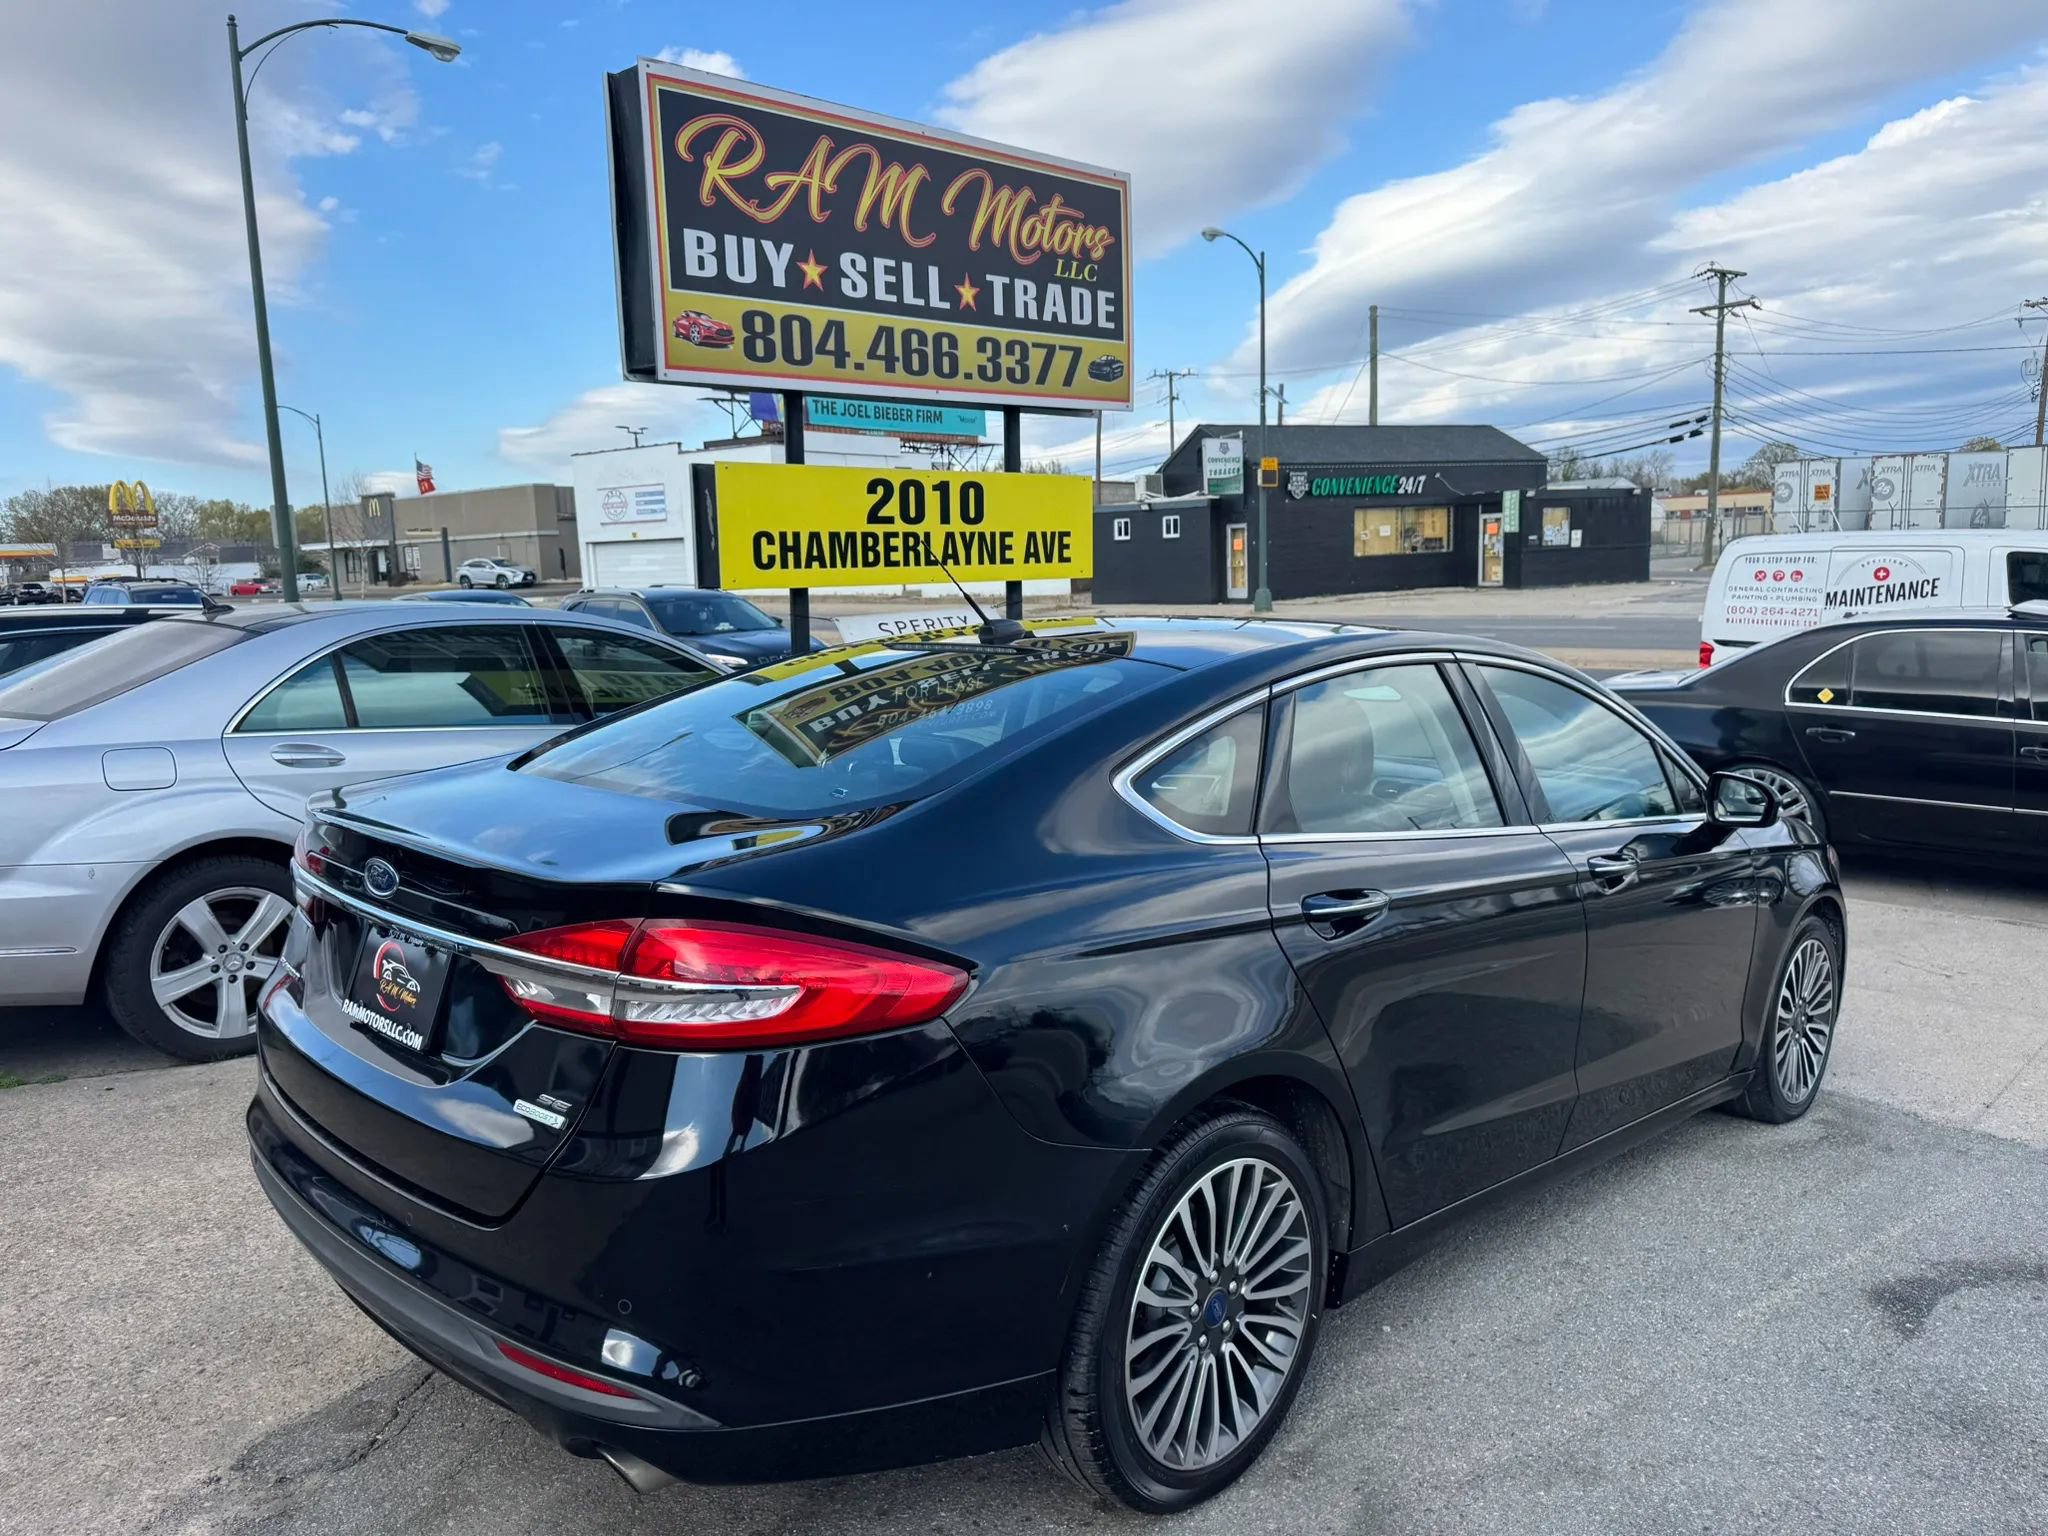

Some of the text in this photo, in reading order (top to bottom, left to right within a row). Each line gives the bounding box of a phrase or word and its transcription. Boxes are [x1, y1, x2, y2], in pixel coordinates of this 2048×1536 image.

[675, 113, 1116, 265] RAM Motors
[683, 228, 1115, 329] BUY SELL TRADE
[1054, 258, 1099, 282] LLC
[741, 310, 1083, 387] 804.466.3377
[812, 399, 837, 416] THE
[840, 401, 871, 419] JOEL
[873, 406, 913, 422] BIEBER
[916, 409, 943, 424] FIRM
[1311, 475, 1398, 496] CONVENIENCE
[1397, 475, 1427, 494] 24/7
[866, 478, 984, 525] 2010
[752, 530, 1071, 570] CHAMBERLAYNE AVE
[1766, 585, 1824, 594] CONTRACTING
[1775, 595, 1818, 603] PLUMBING
[1825, 577, 1941, 608] MAINTENANCE
[1726, 605, 1819, 617] (804) 264-4271
[341, 998, 423, 1051] RAMMOTORSLLC.COM
